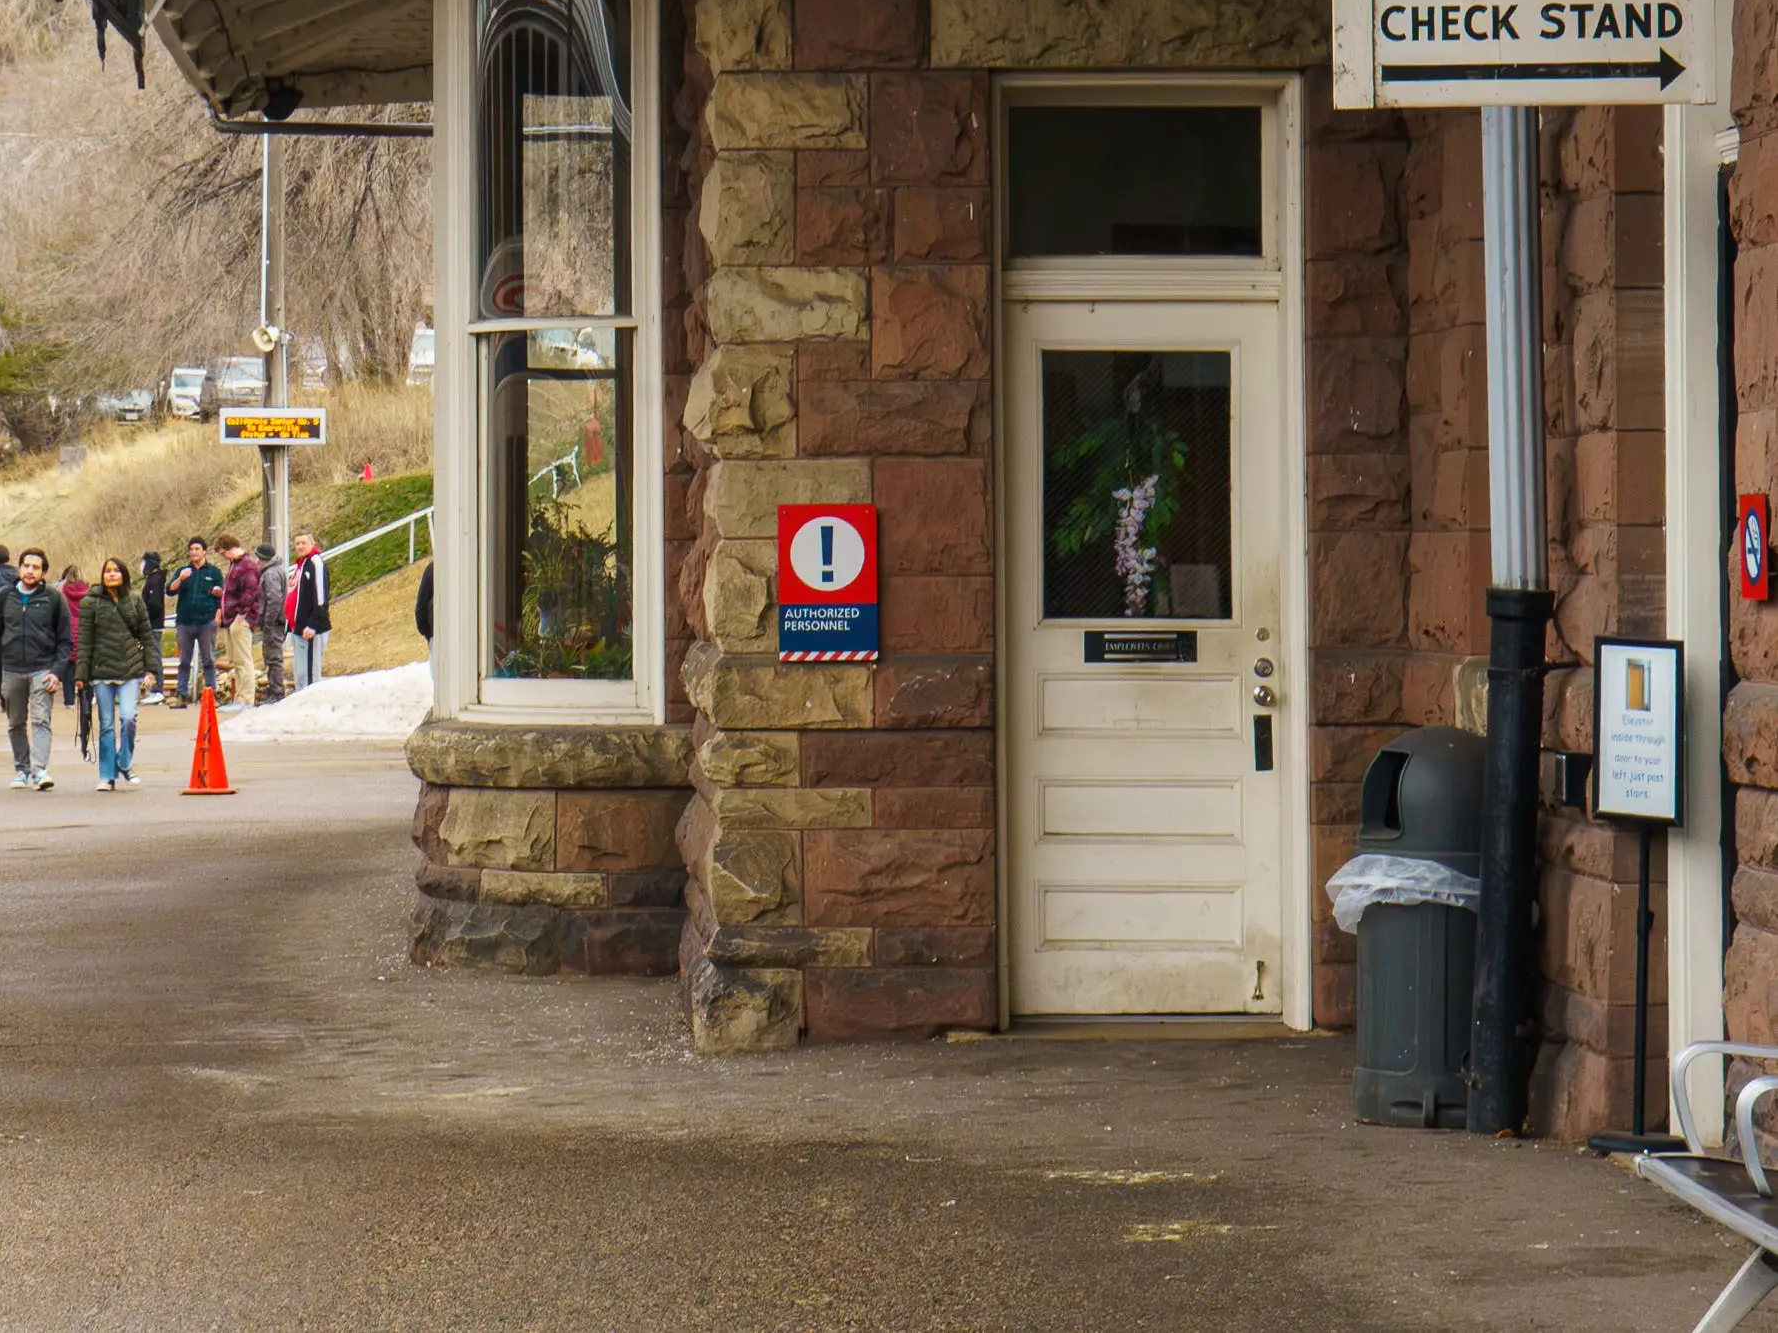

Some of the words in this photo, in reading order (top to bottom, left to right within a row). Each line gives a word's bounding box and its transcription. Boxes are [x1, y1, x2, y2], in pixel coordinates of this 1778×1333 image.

[1380, 4, 1520, 41] CHECK
[1539, 2, 1683, 39] STAND
[784, 607, 860, 619] AUTHORIZED
[784, 620, 850, 631] PERSONNEL
[1622, 714, 1653, 726] Elevator
[1611, 733, 1633, 743] inside
[1635, 733, 1666, 747] through
[1614, 753, 1632, 763] door
[1634, 755, 1643, 764] to
[1644, 757, 1662, 767] your
[1612, 769, 1627, 781] left
[1630, 770, 1645, 783] just
